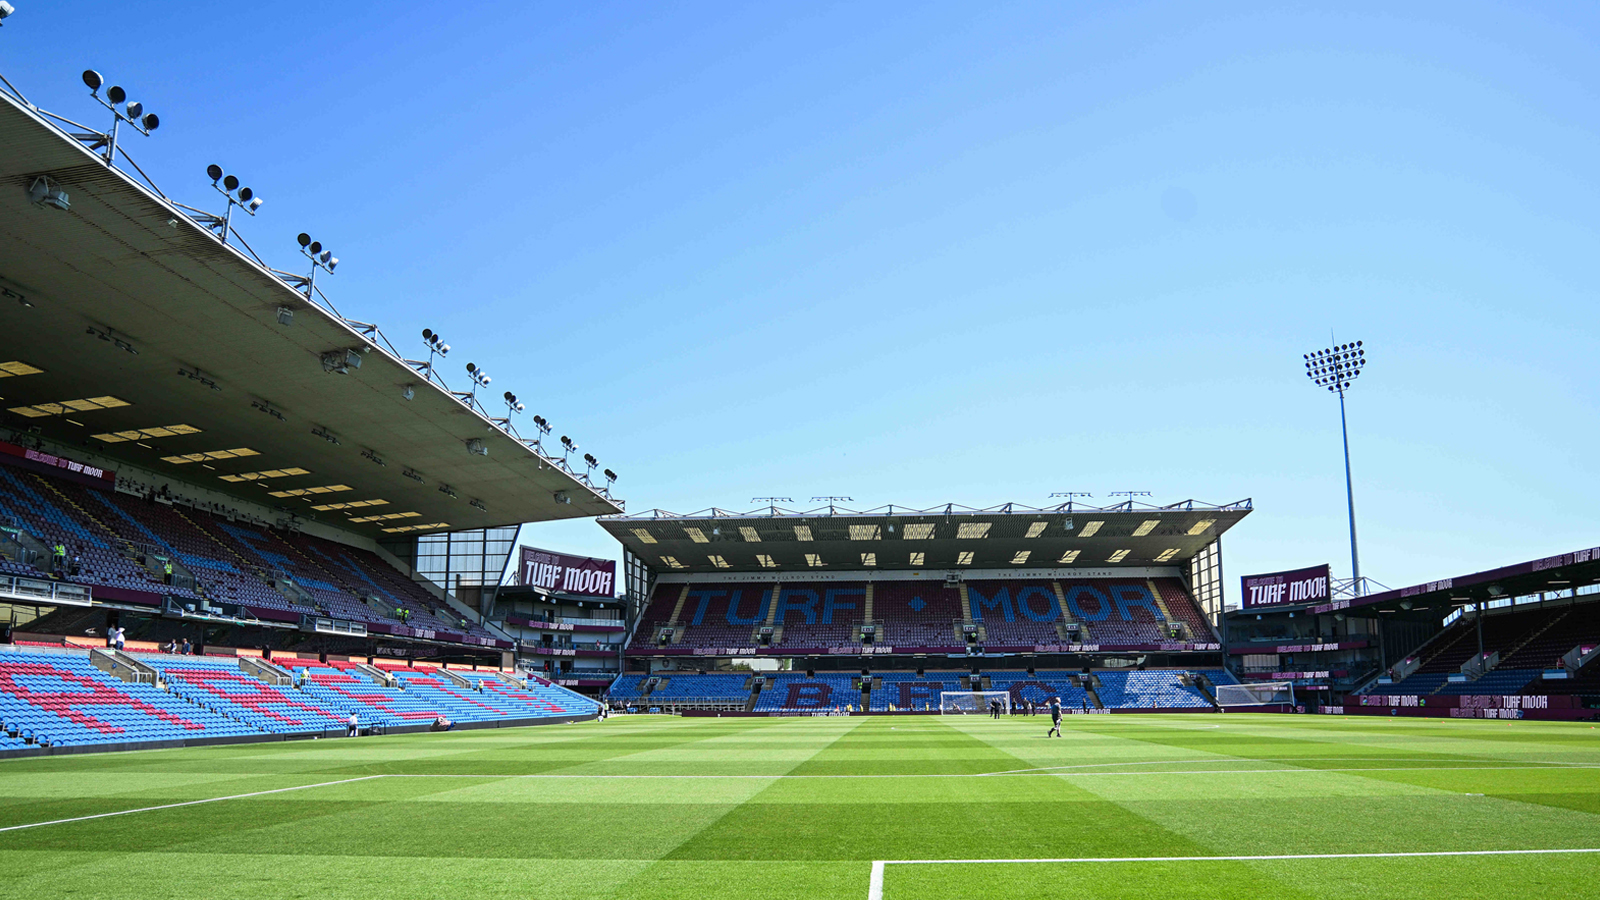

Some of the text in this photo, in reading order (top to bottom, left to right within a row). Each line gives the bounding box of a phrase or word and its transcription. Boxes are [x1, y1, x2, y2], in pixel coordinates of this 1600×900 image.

[68, 461, 84, 472] TURF
[83, 466, 103, 478] MOOR
[1573, 550, 1591, 563] TURF
[525, 561, 612, 595] TURF MOOR
[1250, 576, 1327, 605] TURF MOOR
[688, 584, 1167, 625] TURF MOOR
[1068, 644, 1081, 652] TURF
[1311, 644, 1323, 652] TURF
[1323, 643, 1338, 651] MOOR
[1388, 695, 1400, 706] TURF
[1401, 695, 1418, 707] MOOR
[1502, 695, 1521, 709] TURF
[1522, 695, 1548, 709] MOOR
[1483, 708, 1498, 718] TURF
